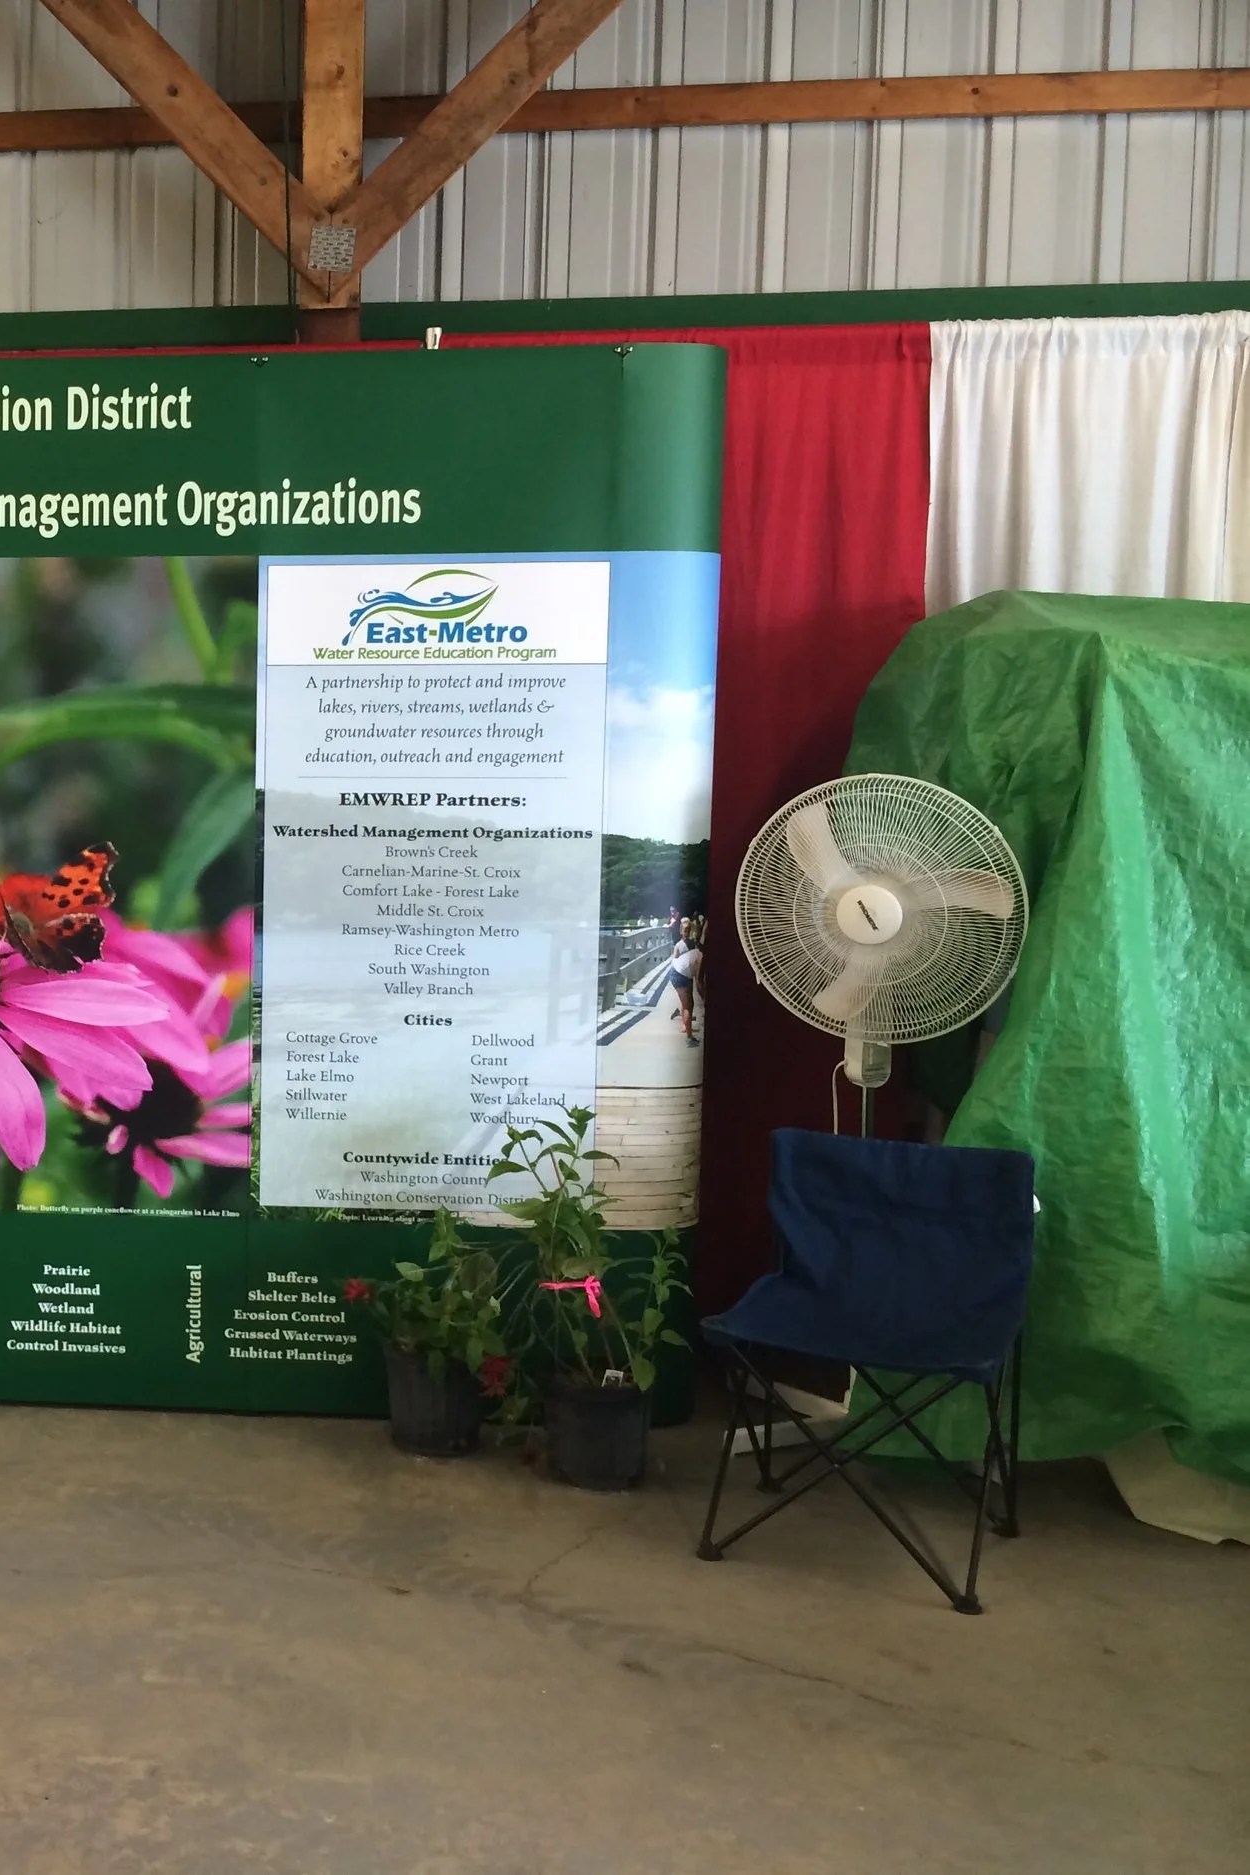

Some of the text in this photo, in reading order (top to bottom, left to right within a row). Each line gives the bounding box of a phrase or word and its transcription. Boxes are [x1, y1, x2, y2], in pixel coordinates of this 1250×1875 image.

[68, 382, 192, 431] District
[177, 477, 421, 537] Organizations
[366, 621, 527, 644] East-Metro
[313, 646, 556, 661] Water Resource Education Program
[306, 675, 566, 694] A partnership to protect and improve
[318, 699, 532, 715] lakes, rivers, streams, wetlands
[324, 724, 544, 742] groundwater resources through
[305, 749, 564, 768] education, outreach and engagement
[339, 793, 526, 807] EMWREP Partners:
[273, 825, 593, 841] Watershed Management Organizations
[385, 845, 478, 858] Brown's Creek
[341, 923, 519, 939] Ramsey-Washington Metro
[368, 962, 490, 978] South Washington
[384, 982, 473, 997] Valley Branch
[404, 1014, 452, 1027] Cities
[286, 1031, 378, 1049] Cottage Grove
[471, 1034, 534, 1048] Dellwood
[286, 1051, 360, 1064] Forest Lake
[470, 1054, 508, 1067] Grant
[286, 1070, 354, 1083] Lake Elmo
[470, 1074, 529, 1090] Newport
[286, 1088, 347, 1102] Stillwater
[470, 1093, 565, 1106] West Lakeland
[286, 1108, 347, 1121] Willernie
[470, 1112, 538, 1129] Woodbury
[343, 1151, 439, 1167] Countywide
[360, 1171, 489, 1188] Washington County
[315, 1189, 483, 1205] Washington Conservation
[43, 1264, 90, 1276] Prairie
[267, 1272, 318, 1285] Buffers
[32, 1283, 100, 1296] Woodland
[248, 1291, 336, 1304] Shelter Belts
[38, 1302, 94, 1315] Wetland
[185, 1264, 204, 1363] Agricultural
[234, 1309, 345, 1323] Erosion Control
[11, 1320, 122, 1335] Wildlife Habitat
[225, 1328, 357, 1345] Grassed Waterways
[7, 1339, 126, 1354] Control Invasives
[229, 1347, 353, 1364] Habitat Plantings
